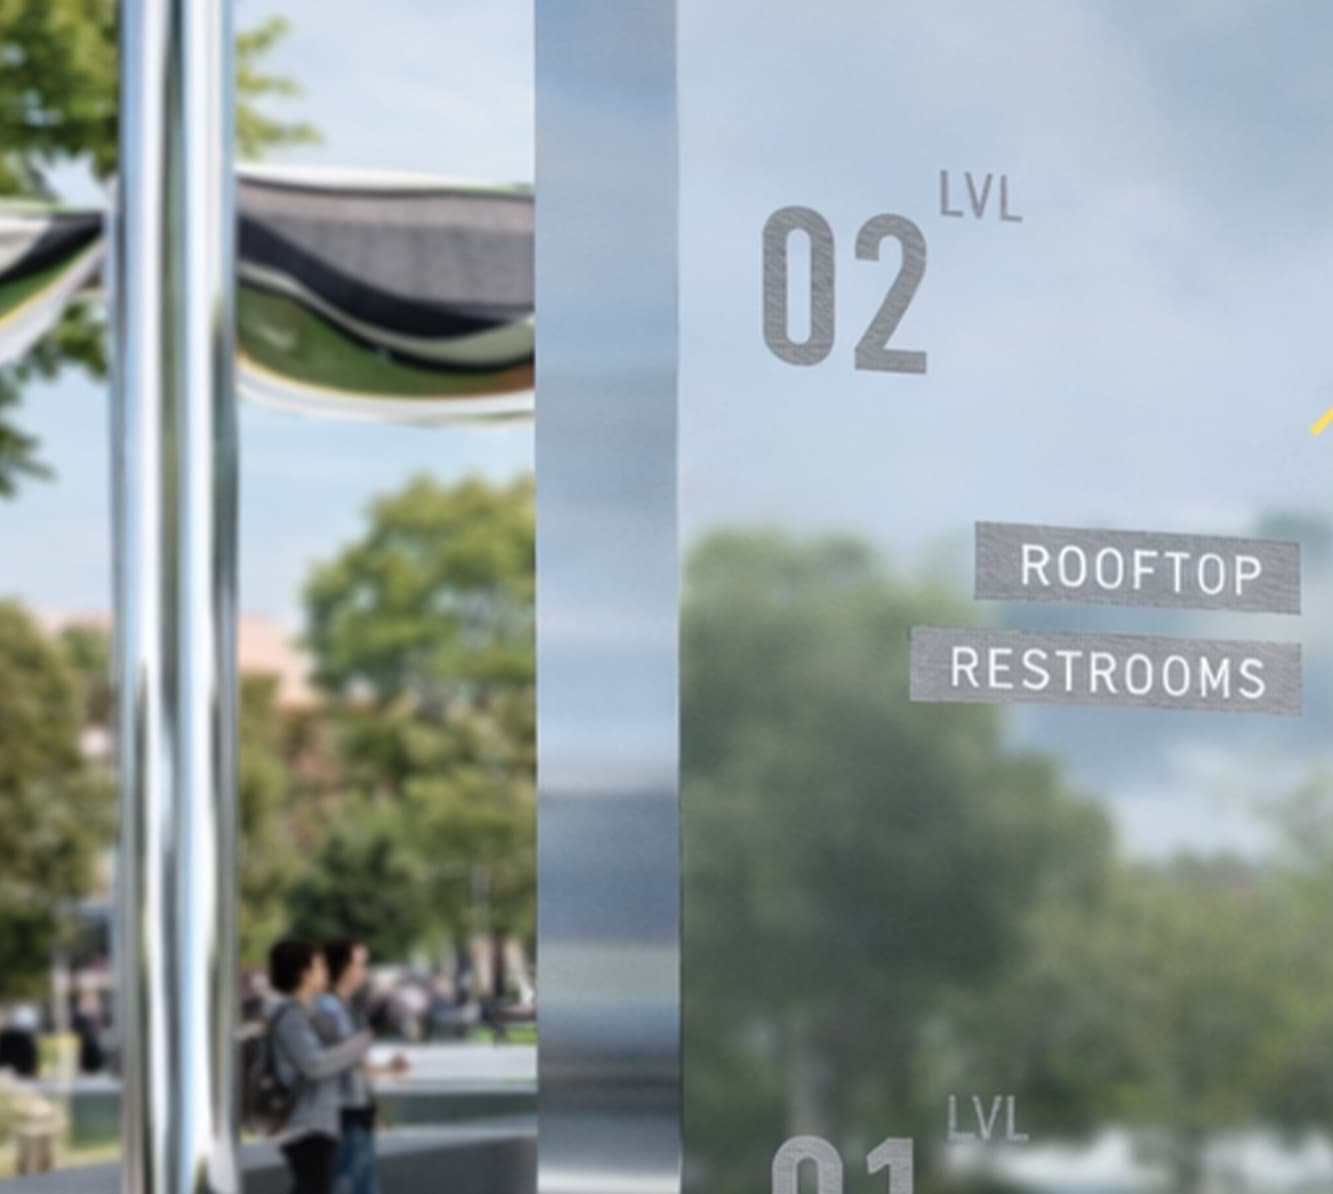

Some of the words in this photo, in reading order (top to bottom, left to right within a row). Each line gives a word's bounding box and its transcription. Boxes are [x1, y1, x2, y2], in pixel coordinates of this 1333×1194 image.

[762, 204, 927, 375] 02
[939, 168, 1023, 223] LVL
[1019, 543, 1263, 598] ROOFTOP
[950, 645, 1267, 700] RESTROOMS
[947, 1095, 1030, 1142] LVL
